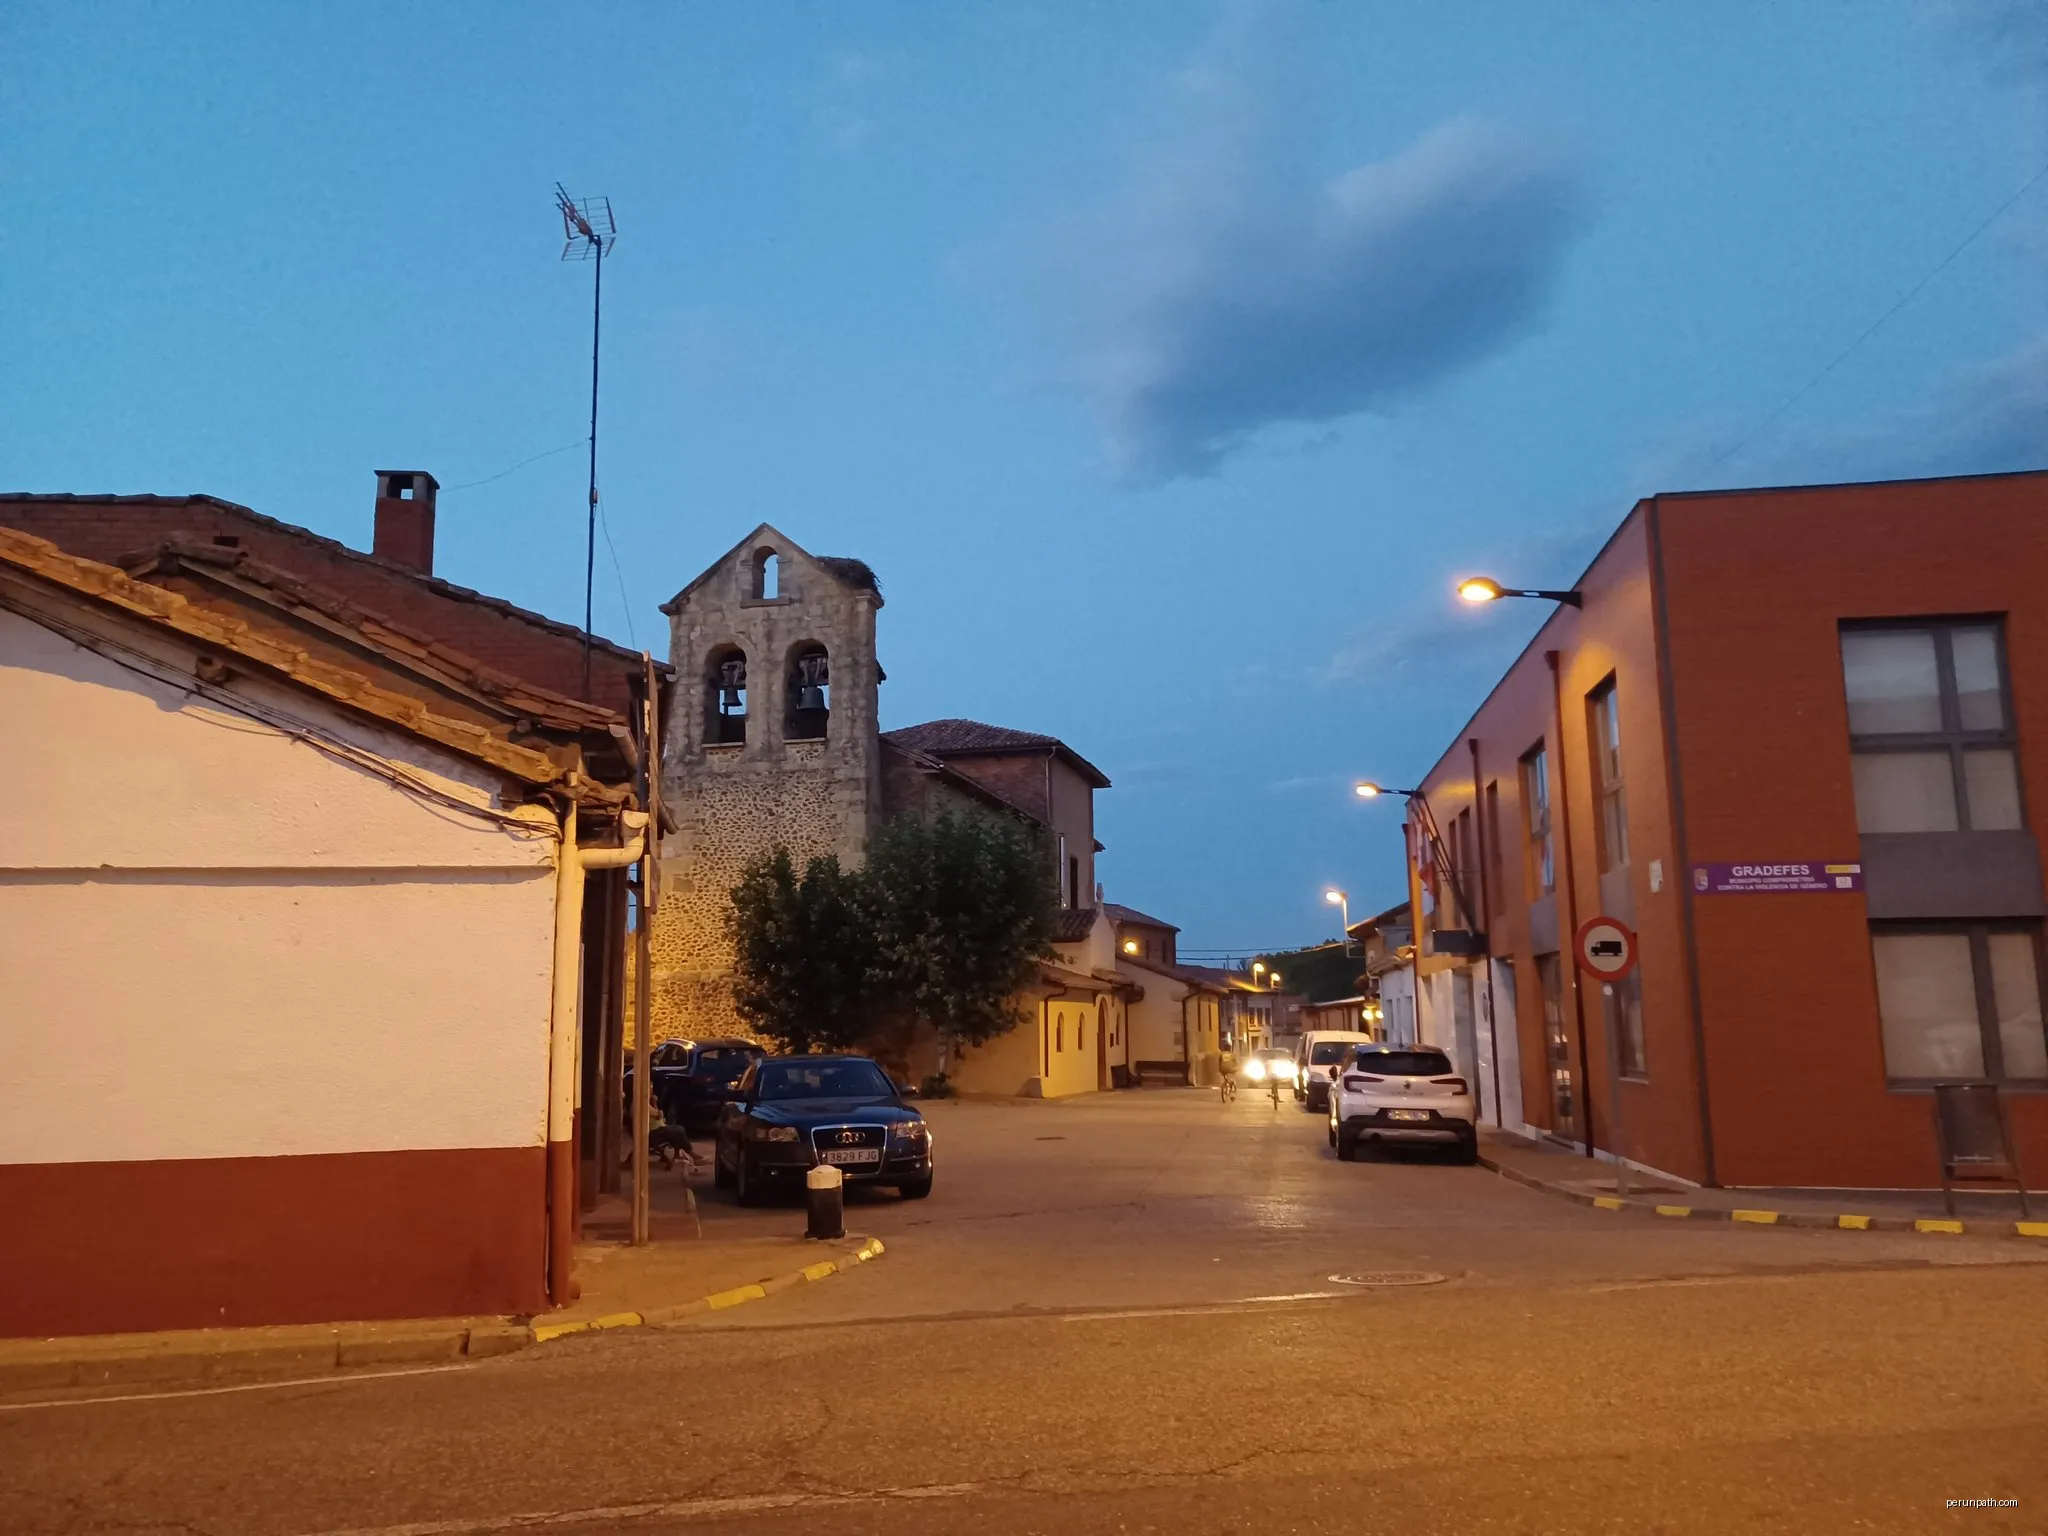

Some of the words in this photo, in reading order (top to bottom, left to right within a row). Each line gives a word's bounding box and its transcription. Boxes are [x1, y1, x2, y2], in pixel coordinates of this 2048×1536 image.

[1732, 865, 1810, 876] GRADEFES
[830, 1152, 855, 1162] 3829
[858, 1151, 877, 1161] FJG
